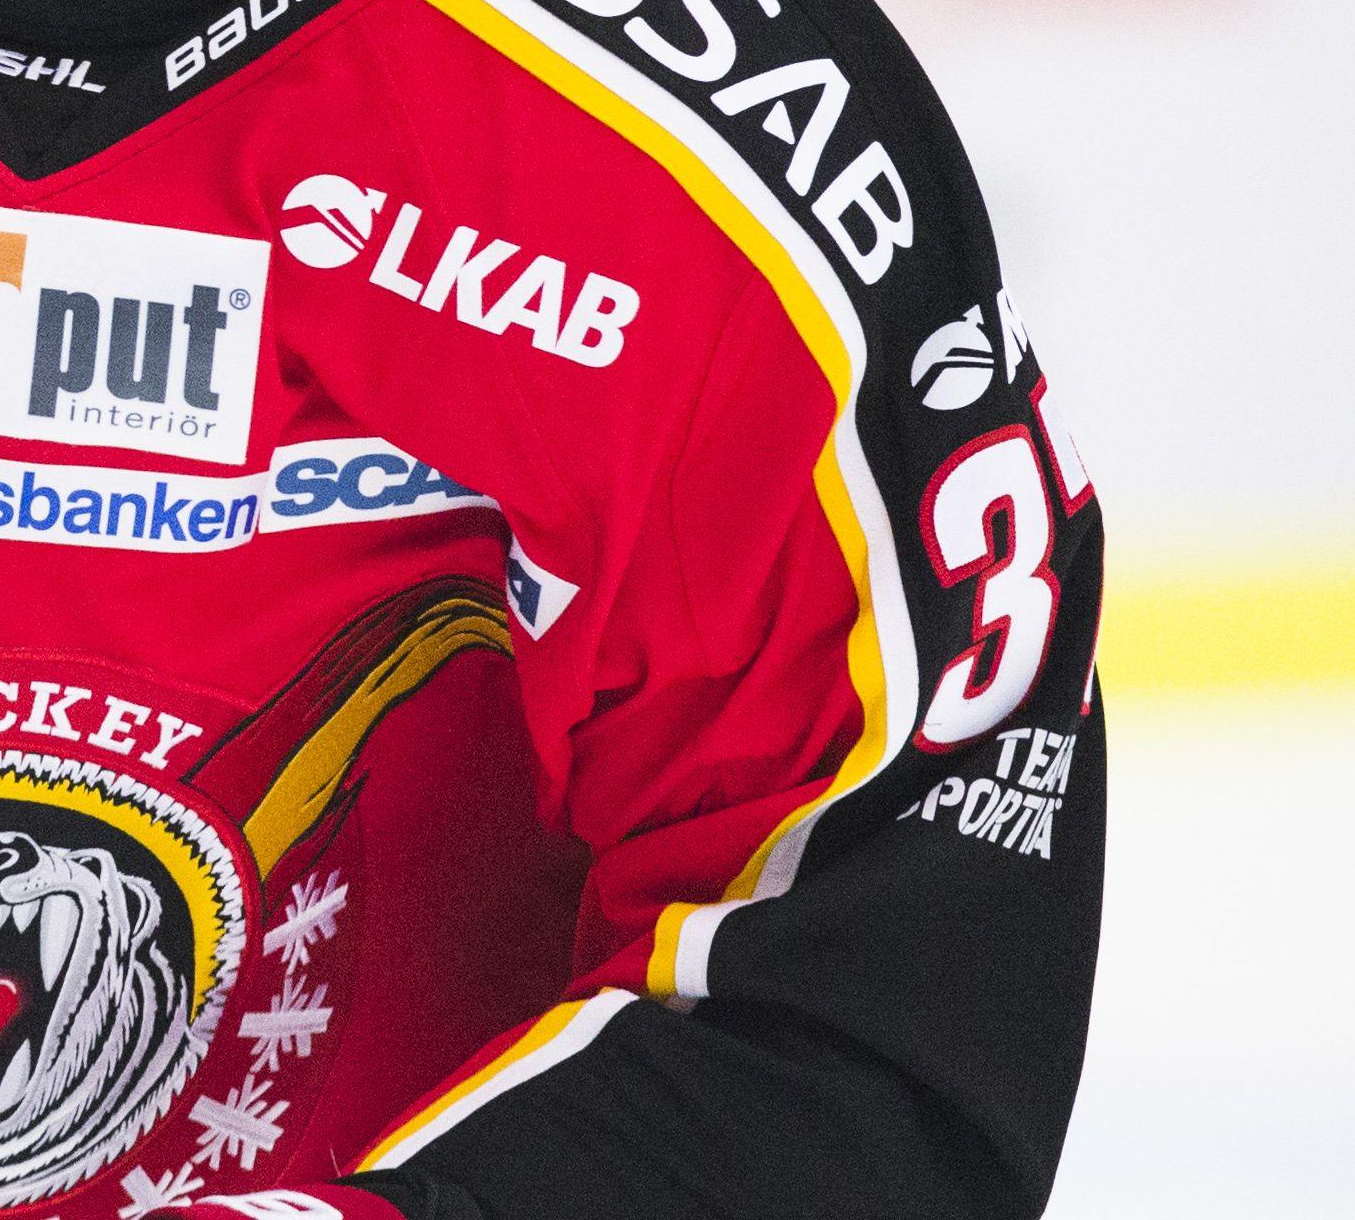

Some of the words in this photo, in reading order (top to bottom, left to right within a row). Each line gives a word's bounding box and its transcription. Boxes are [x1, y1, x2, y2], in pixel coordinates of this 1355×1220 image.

[370, 202, 641, 369] LKAB
[68, 397, 217, 440] interiör
[895, 776, 1053, 861] PORTIA
